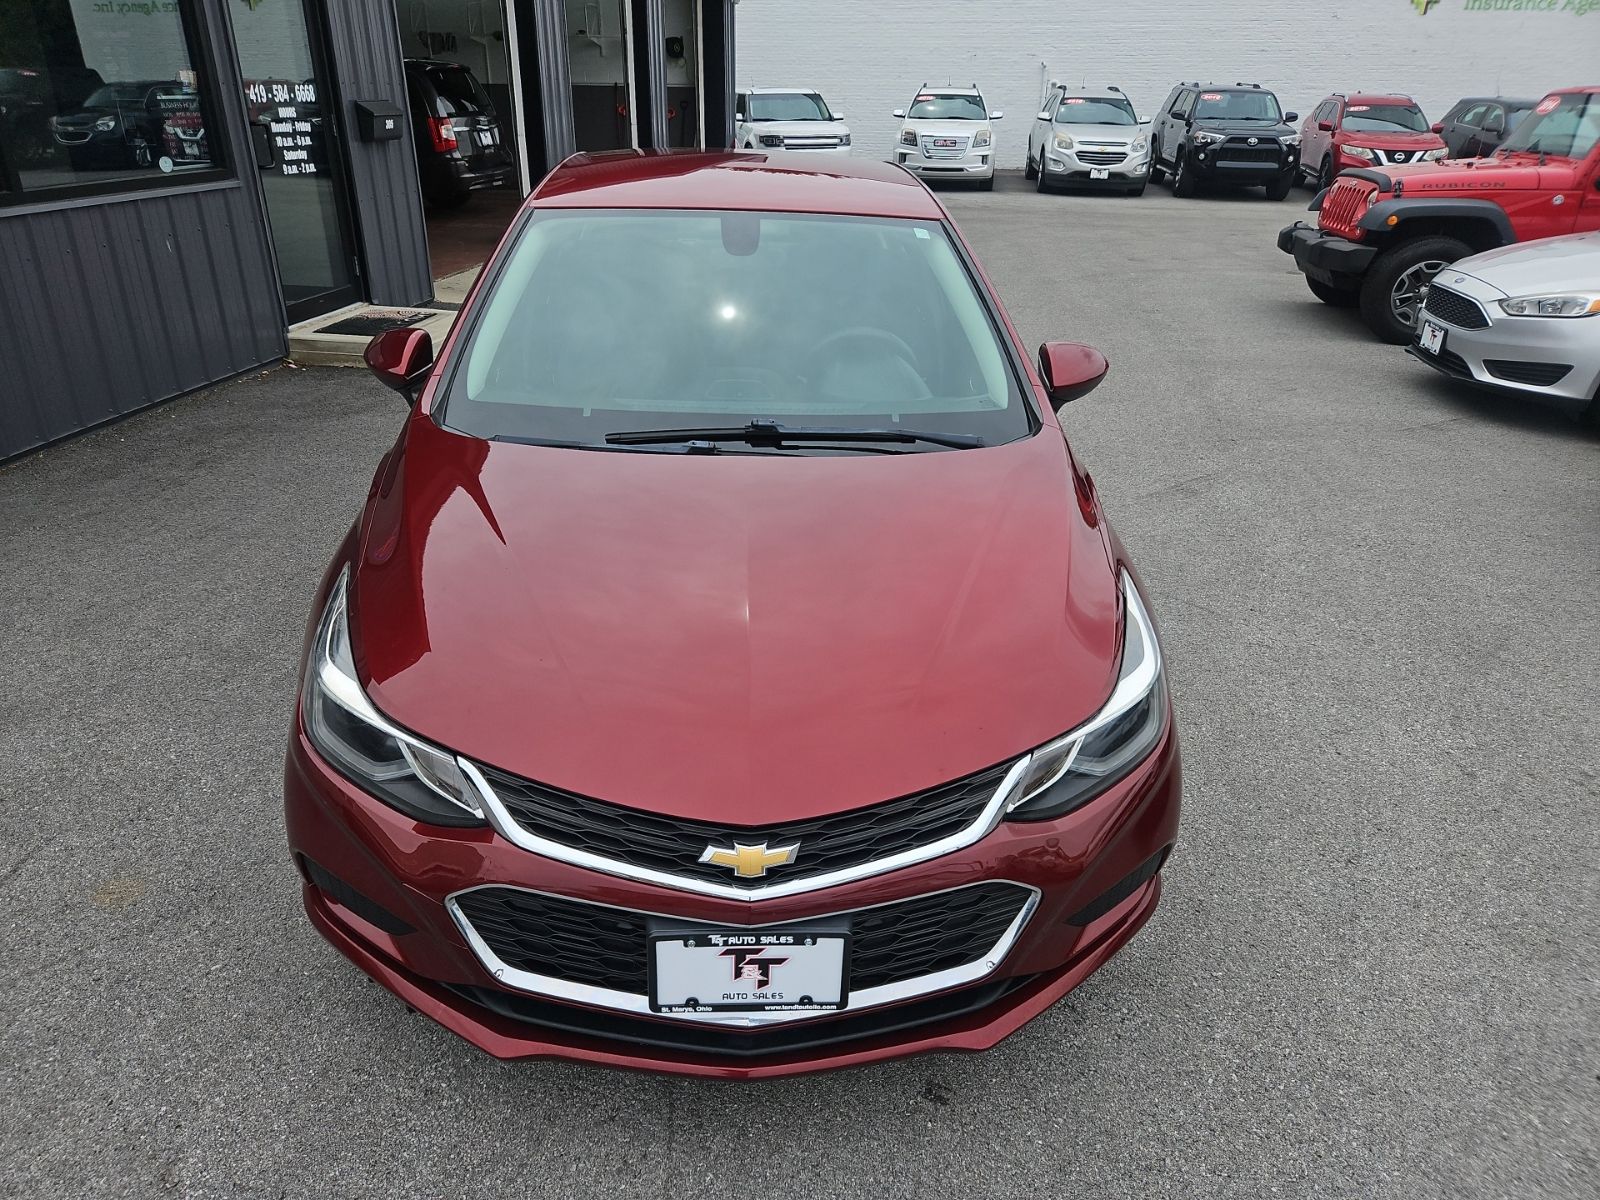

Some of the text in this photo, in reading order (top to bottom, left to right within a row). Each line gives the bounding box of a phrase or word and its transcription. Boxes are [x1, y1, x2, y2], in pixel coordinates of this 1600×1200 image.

[1463, 0, 1555, 11] Insurance
[249, 84, 267, 103] 419
[272, 84, 290, 102] 584
[294, 84, 316, 102] 6668
[277, 106, 297, 118] HOURS
[270, 121, 293, 133] Monday
[294, 121, 312, 132] Friday
[283, 149, 308, 160] Saturday
[728, 936, 756, 945] AUTO
[760, 935, 794, 944] SALES
[722, 991, 784, 1001] AUTO SALES
